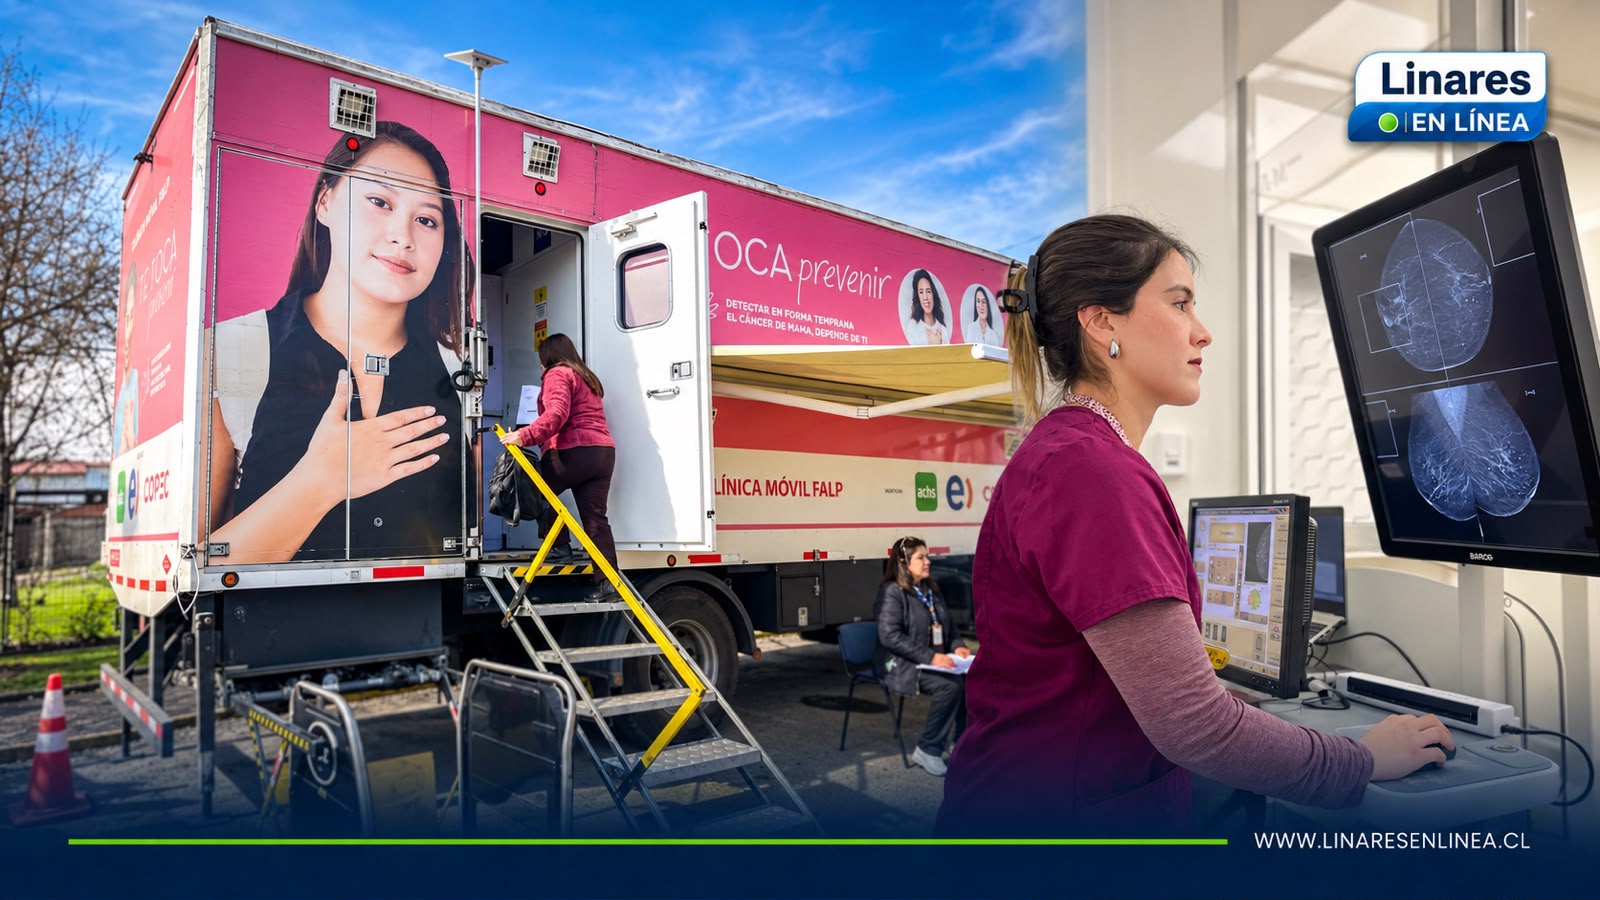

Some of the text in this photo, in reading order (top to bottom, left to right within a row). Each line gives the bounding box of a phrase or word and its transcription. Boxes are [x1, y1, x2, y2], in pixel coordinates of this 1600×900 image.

[713, 230, 892, 305] OCA prevenir
[726, 298, 855, 330] DETECTAR EN FORMA TEMPRANA
[726, 312, 738, 322] EL
[739, 312, 774, 329] CÁNCER
[775, 320, 787, 331] DE
[815, 327, 849, 341] DEPENDE
[850, 333, 860, 343] DE
[861, 335, 868, 345] TI
[144, 469, 169, 504] COPEC
[714, 473, 843, 498] LÍNICA MÓVIL FALP
[916, 485, 937, 500] achs
